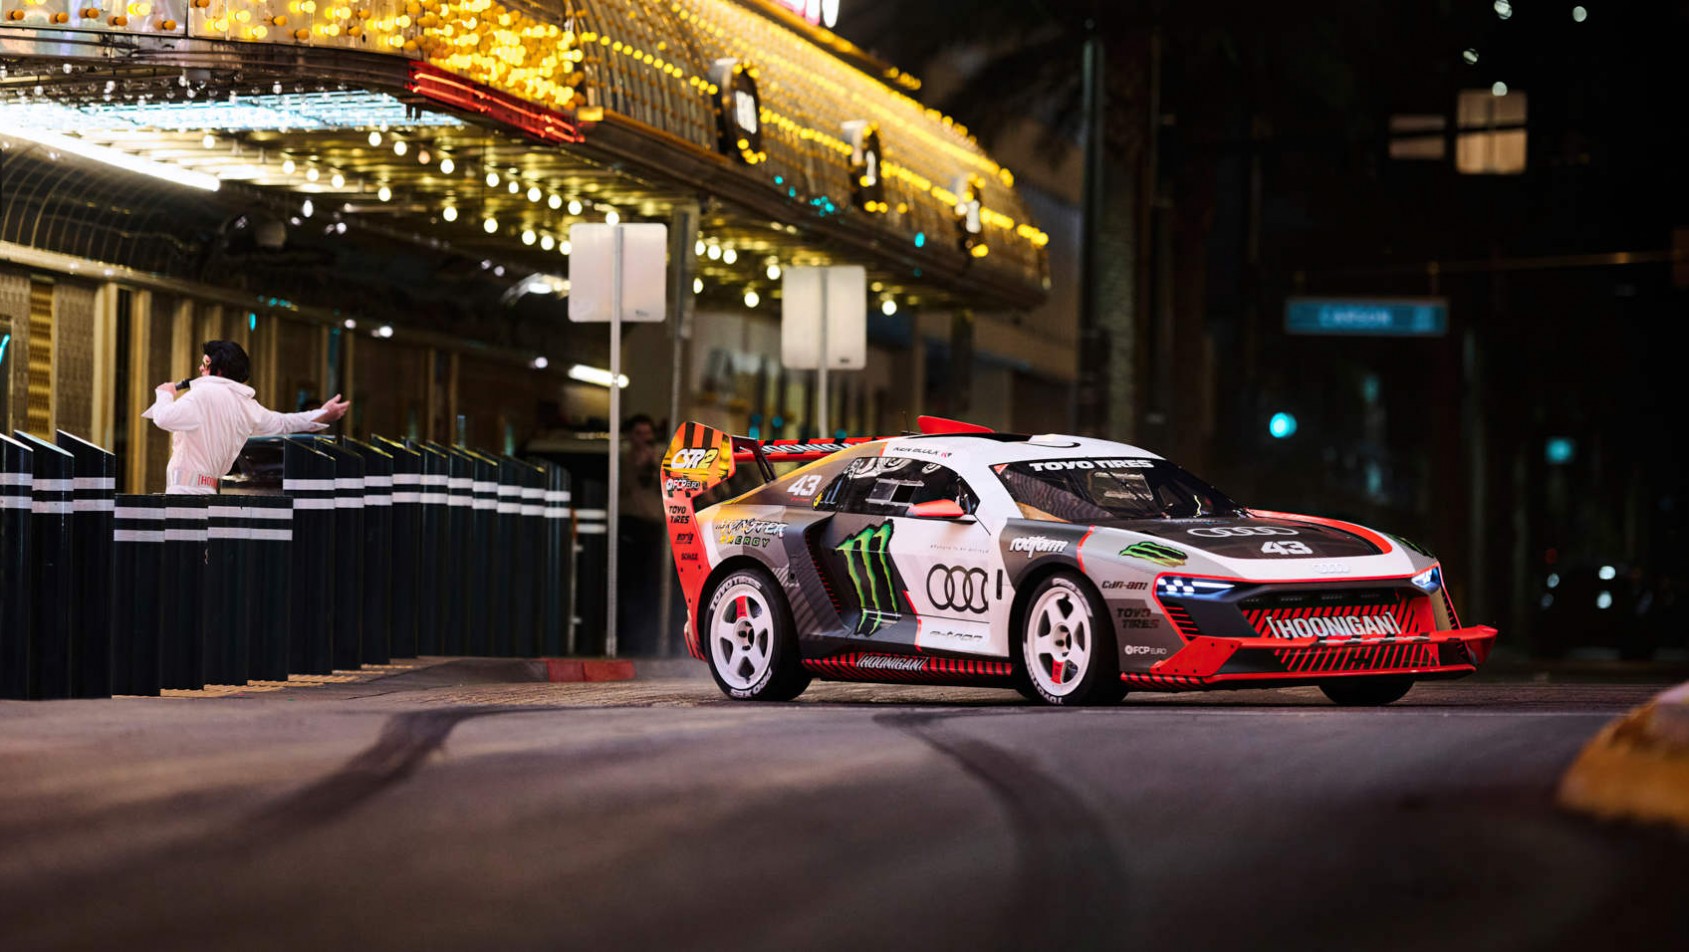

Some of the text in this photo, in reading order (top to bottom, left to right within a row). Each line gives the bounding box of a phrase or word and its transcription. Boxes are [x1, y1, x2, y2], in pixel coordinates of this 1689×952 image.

[671, 448, 719, 469] CSR2
[1029, 458, 1155, 472] TOYO TIRES
[786, 474, 823, 497] 43
[669, 505, 686, 514] TOYO
[670, 516, 690, 524] TIRES
[1260, 540, 1313, 555] 43
[1117, 607, 1151, 617] TOYO
[1122, 619, 1160, 629] TIRES
[1133, 645, 1167, 655] FCP EURO
